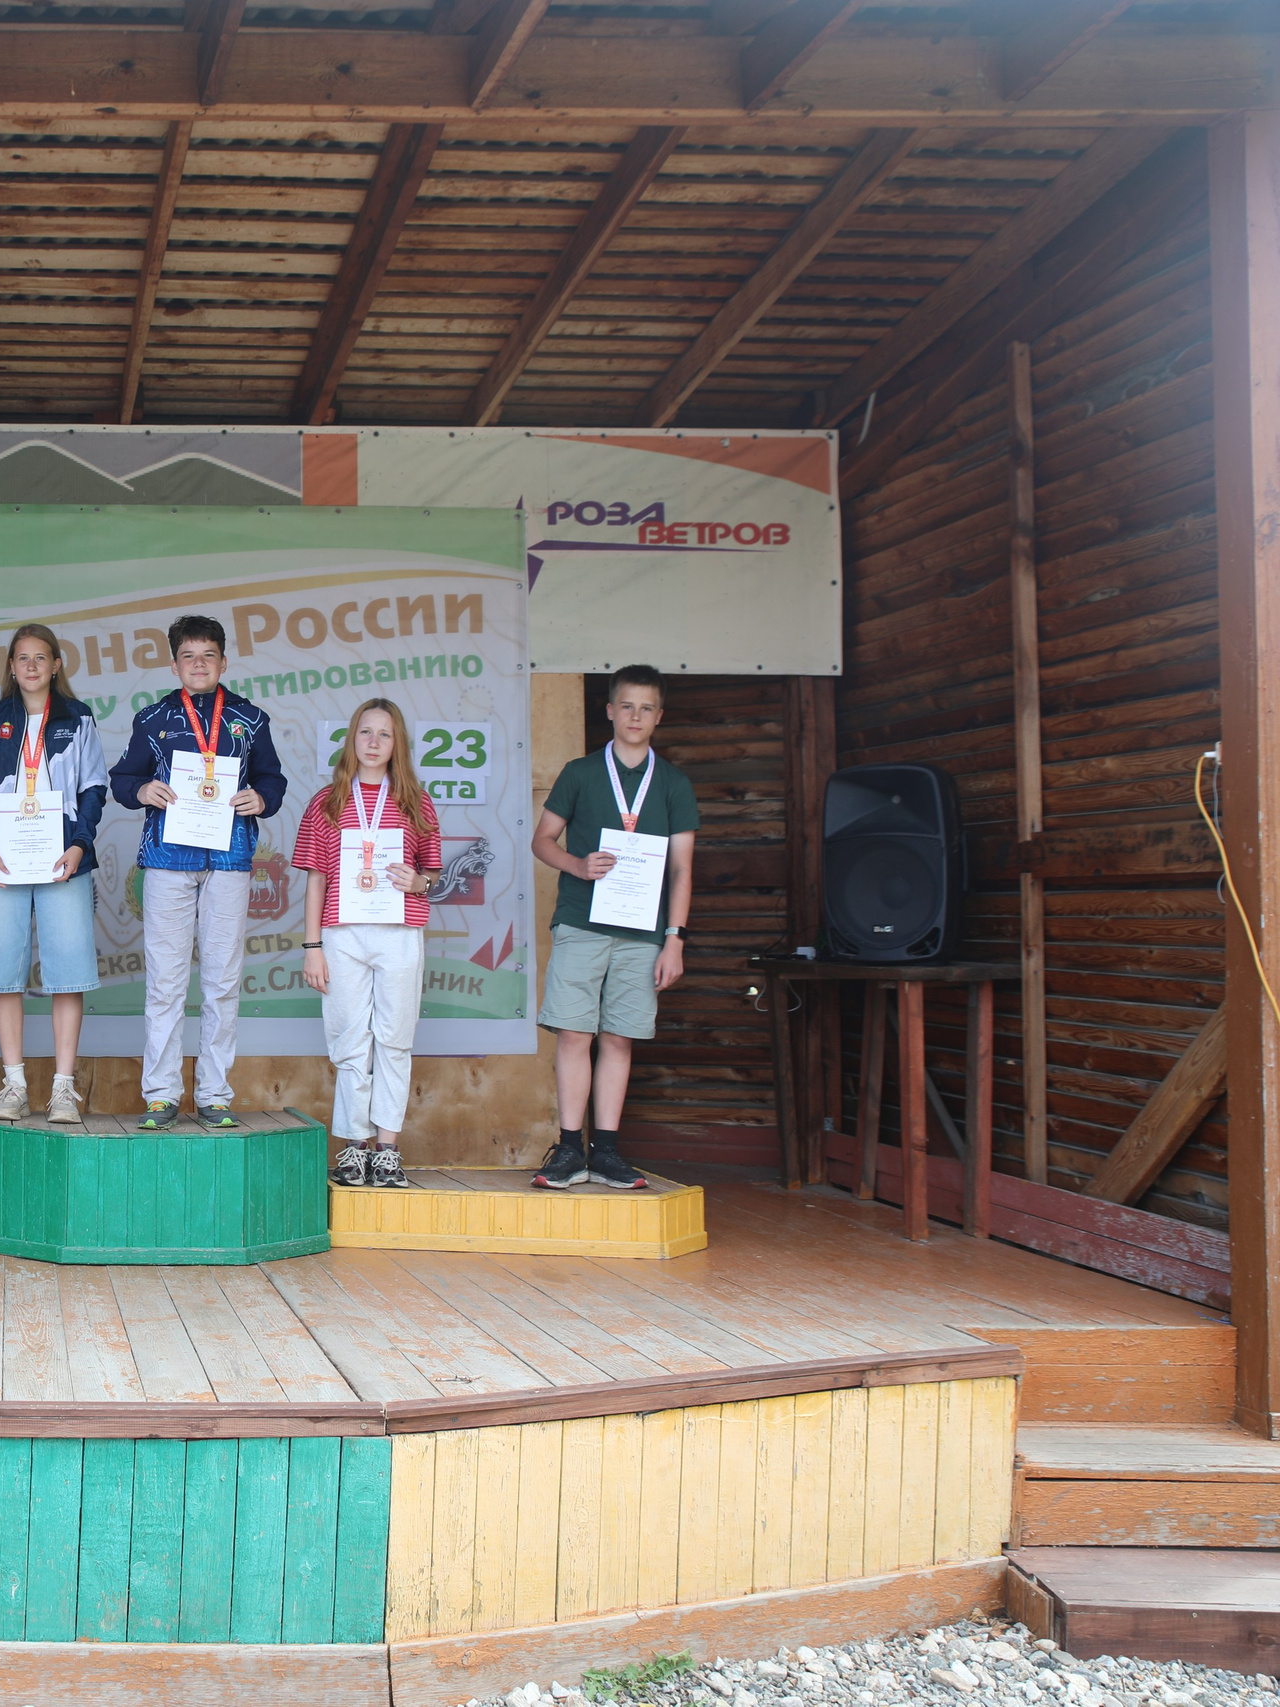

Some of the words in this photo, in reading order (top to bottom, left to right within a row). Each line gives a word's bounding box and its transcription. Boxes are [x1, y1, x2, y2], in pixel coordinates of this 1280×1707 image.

[547, 501, 665, 526] РОЗА
[638, 522, 791, 545] ВЕТРОВ
[231, 593, 484, 658] России
